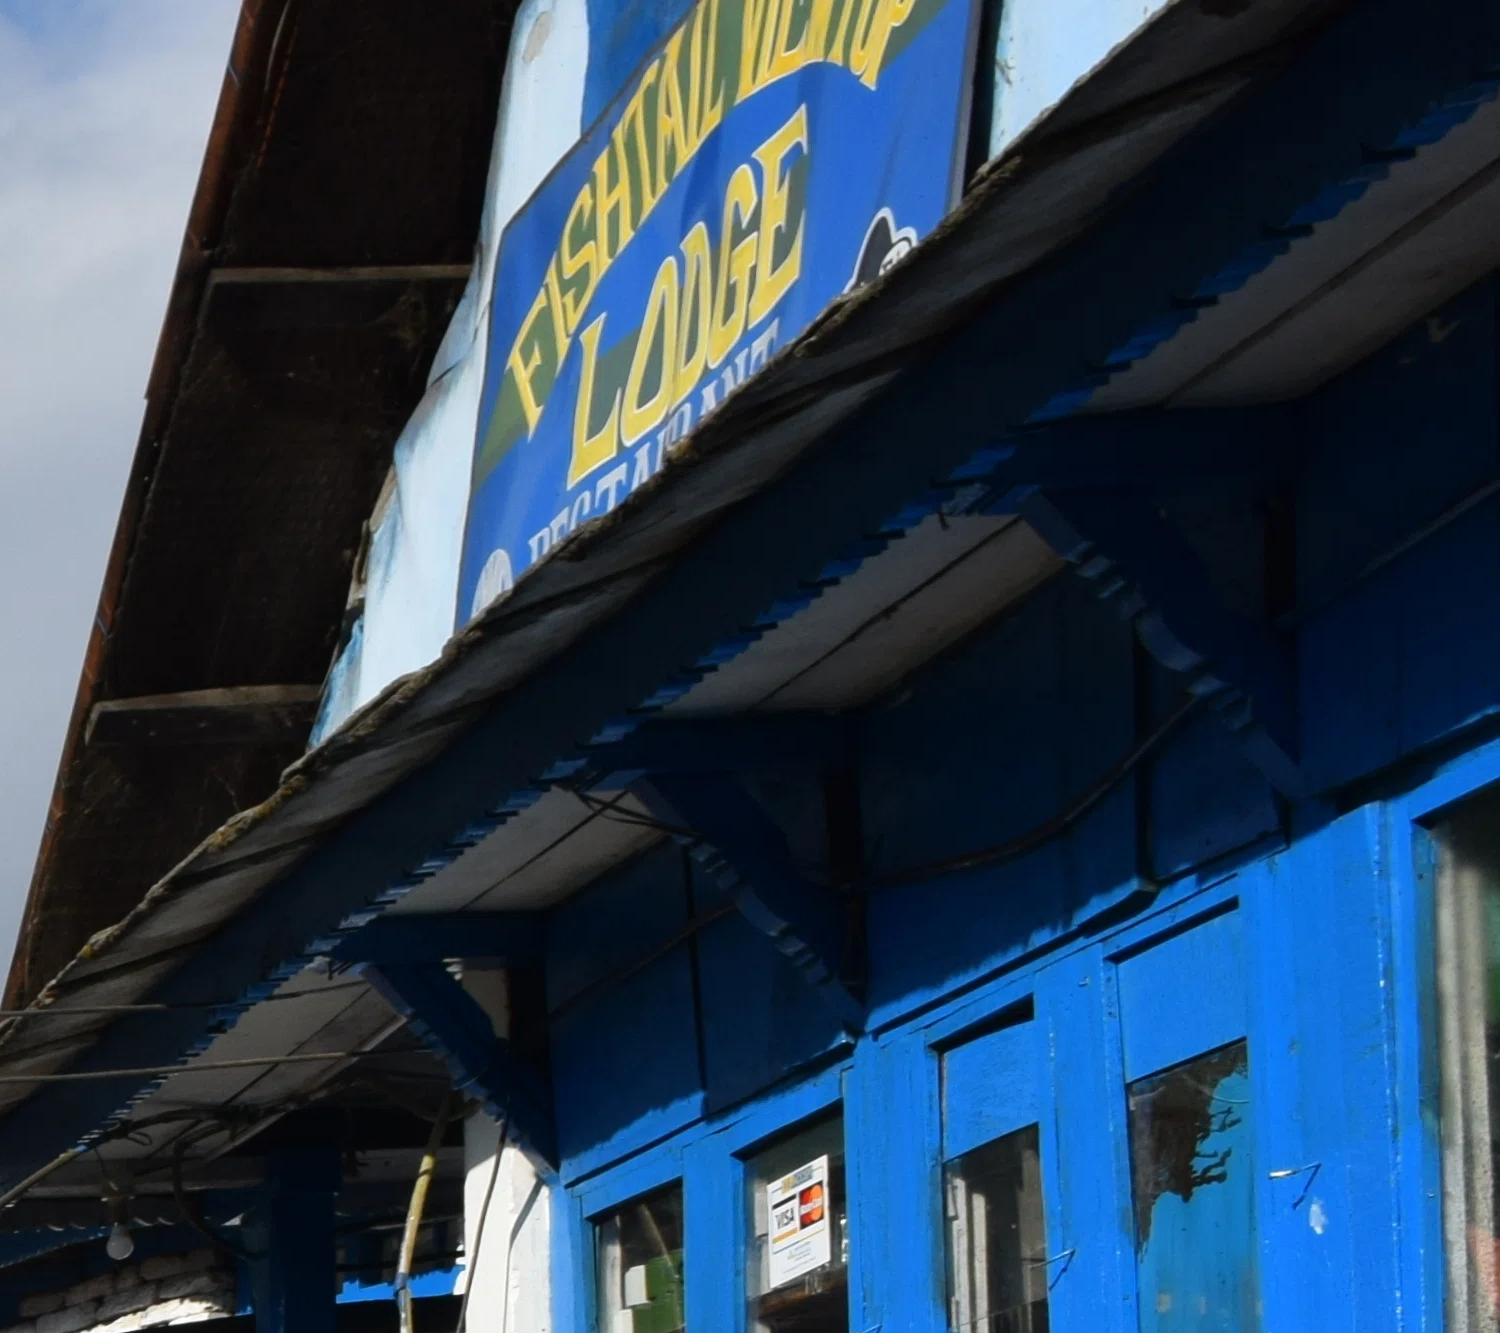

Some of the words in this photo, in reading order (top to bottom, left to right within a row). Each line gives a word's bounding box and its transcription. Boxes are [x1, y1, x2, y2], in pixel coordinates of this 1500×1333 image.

[505, 0, 726, 442] FISHTAIL
[566, 103, 807, 491] LODGE
[775, 1207, 794, 1230] VISA
